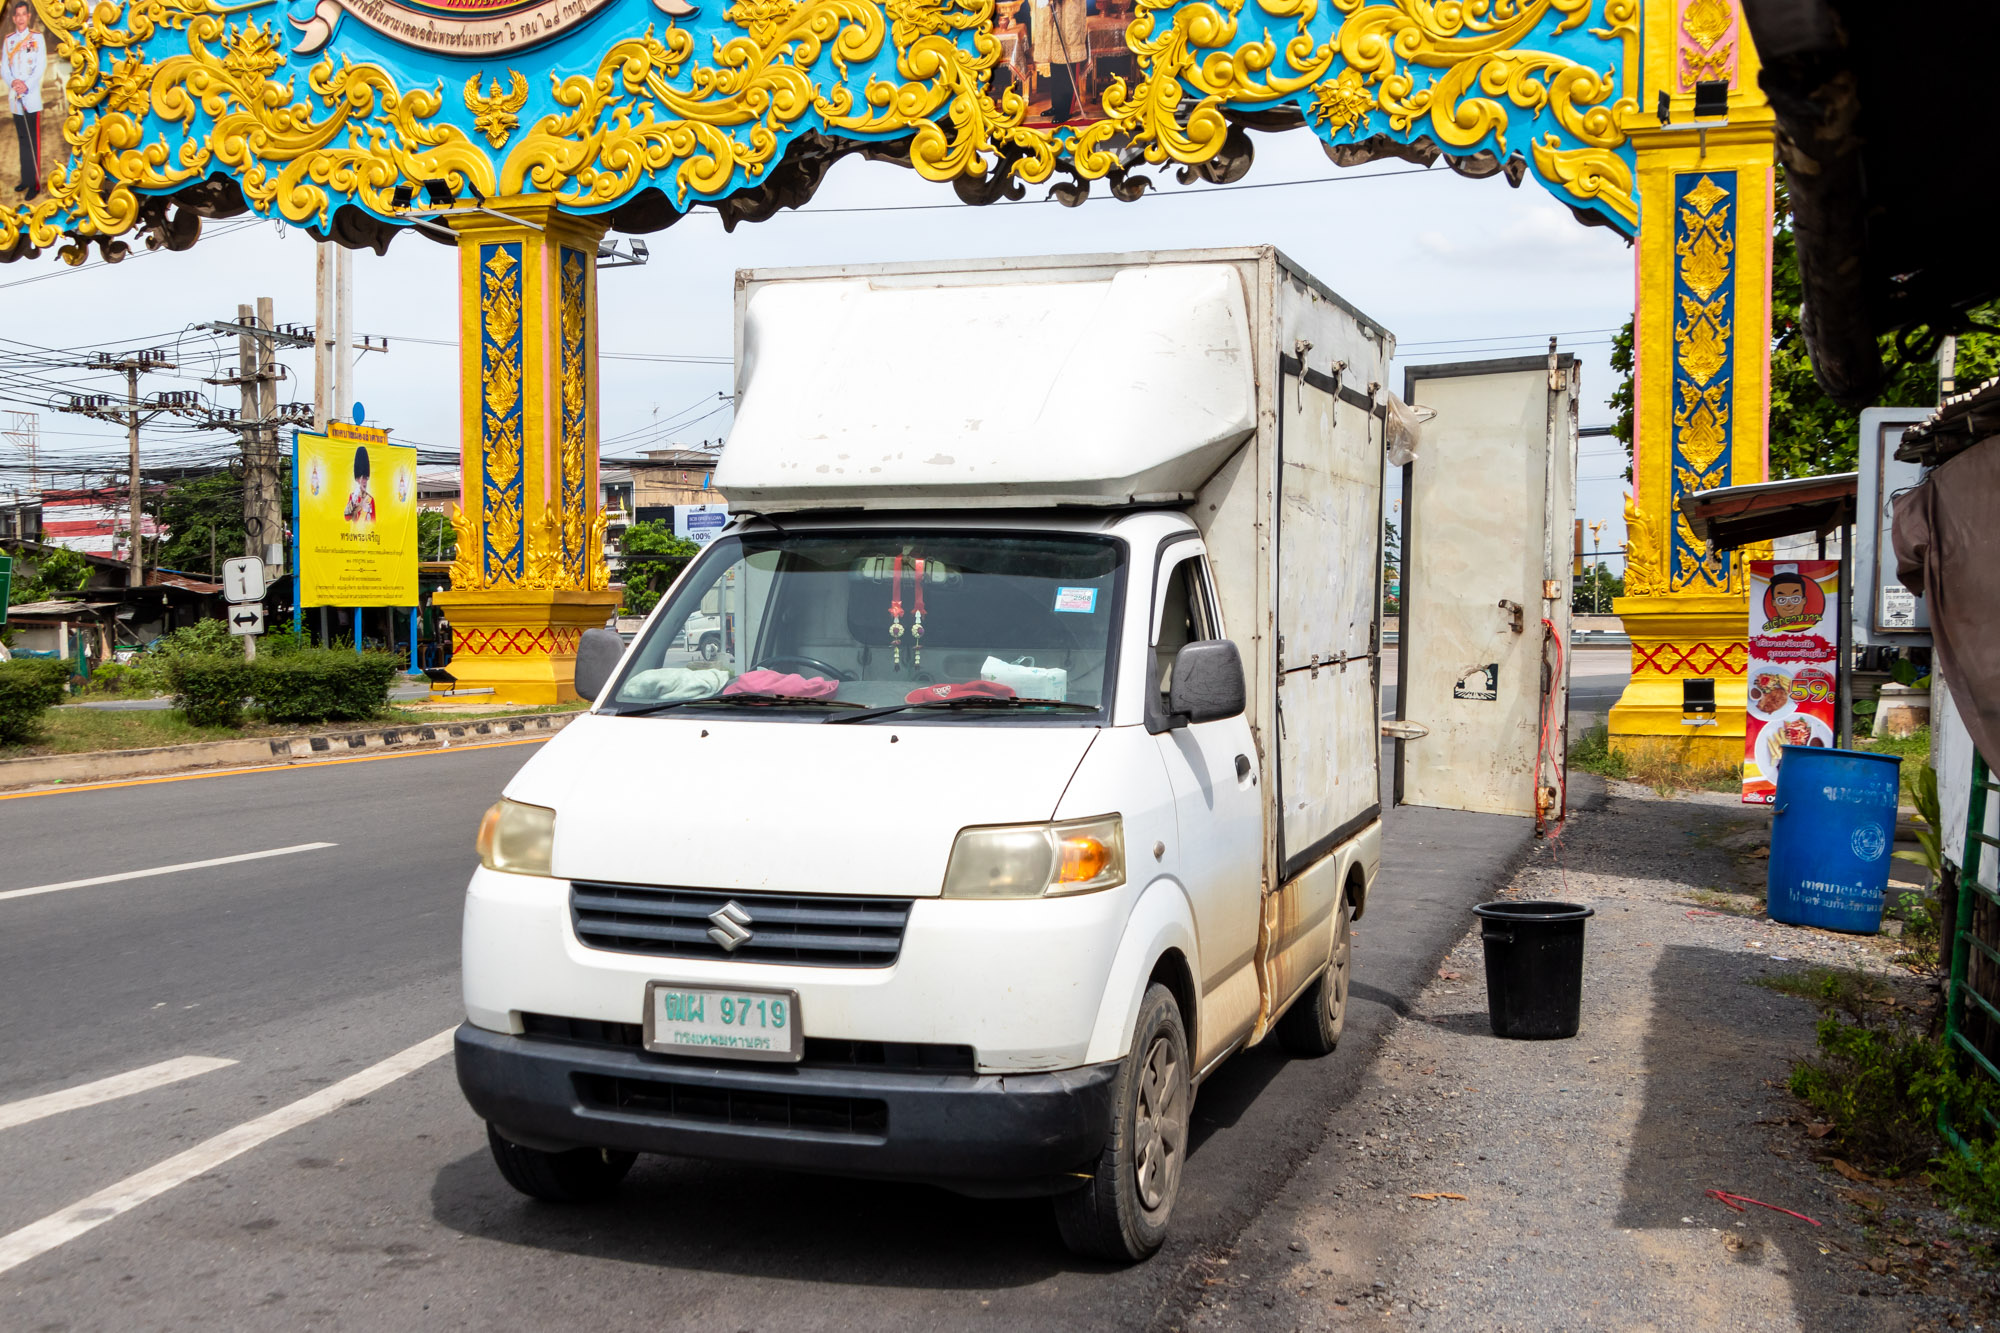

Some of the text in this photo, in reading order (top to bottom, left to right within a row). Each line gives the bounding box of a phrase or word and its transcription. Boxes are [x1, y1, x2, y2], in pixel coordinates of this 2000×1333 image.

[504, 21, 516, 42] ๖
[520, 20, 539, 39] รอบ
[340, 531, 381, 545] ทรงพระเจริญ
[238, 577, 246, 594] 1
[720, 997, 786, 1029] 9719
[674, 1031, 771, 1050] กรงเทพมหานคร
